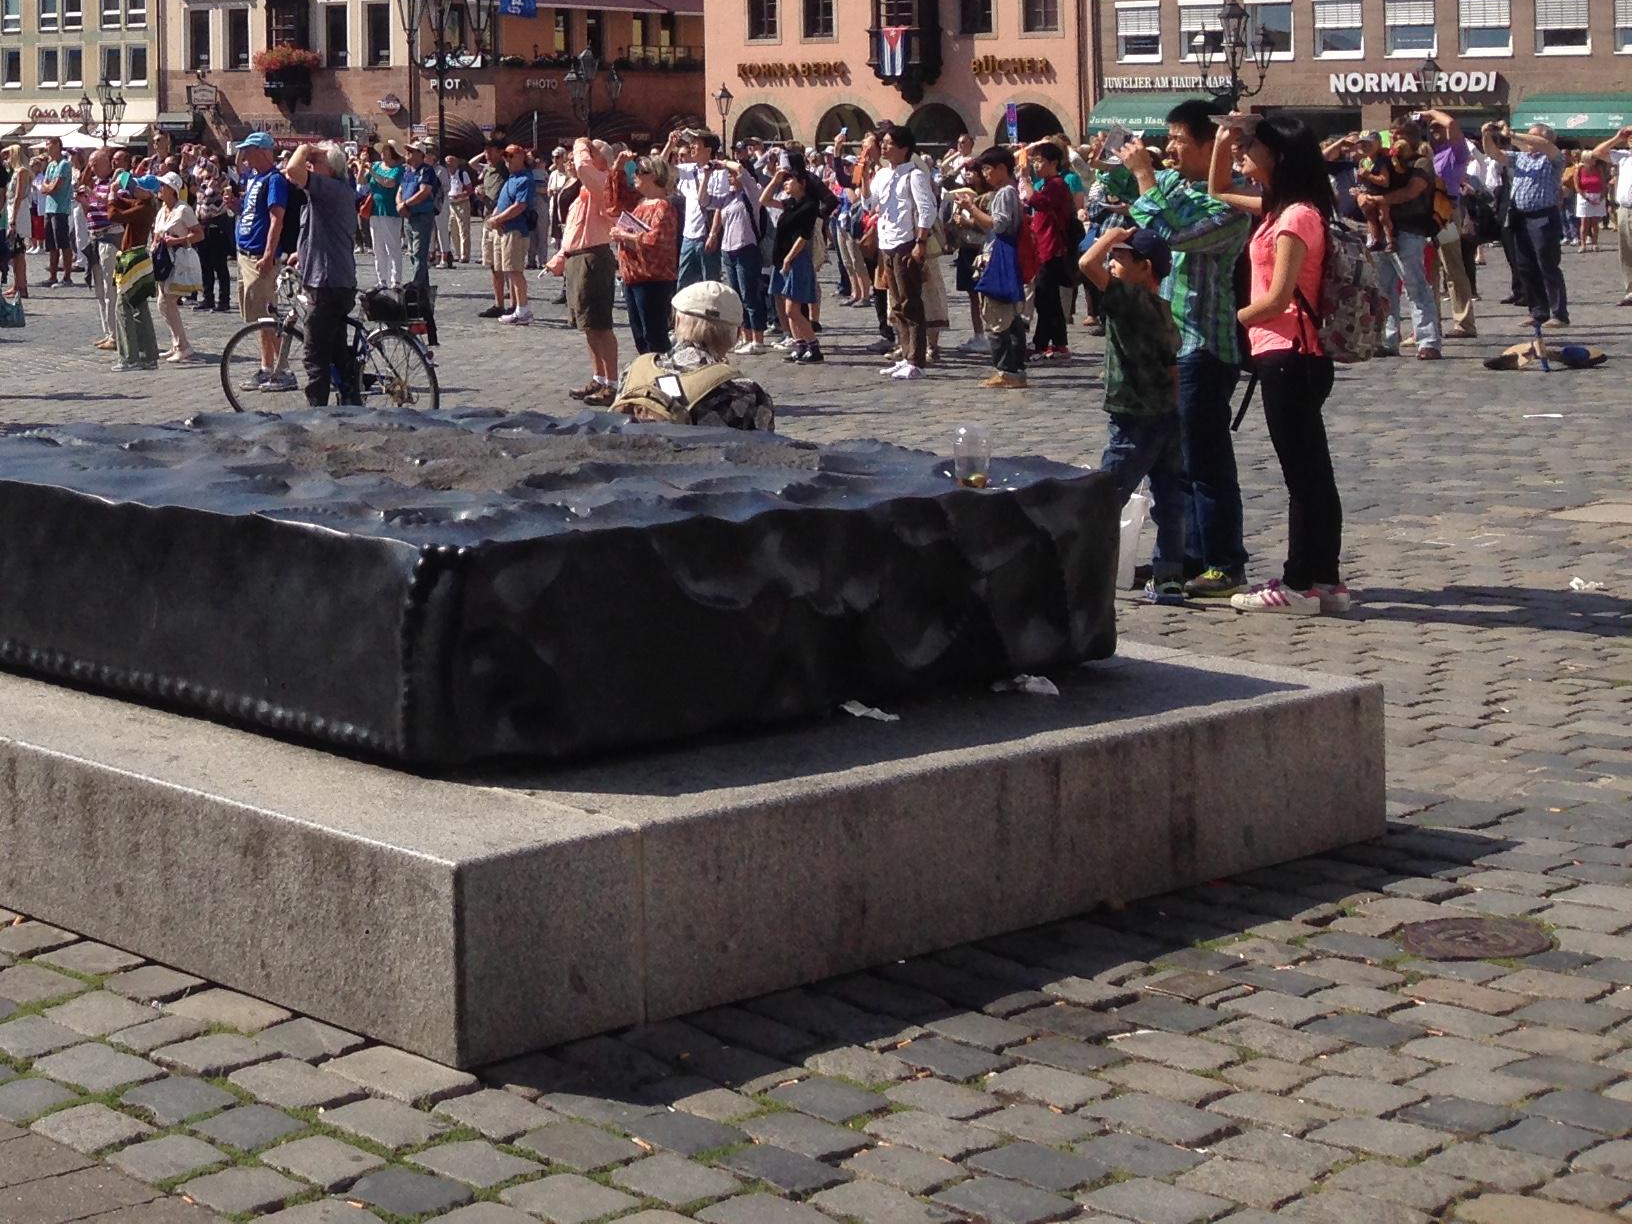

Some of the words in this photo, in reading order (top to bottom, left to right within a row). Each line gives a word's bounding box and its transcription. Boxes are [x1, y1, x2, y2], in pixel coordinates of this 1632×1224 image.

[971, 55, 1050, 76] BÜCHER
[526, 78, 558, 90] PHOTO
[1103, 76, 1152, 89] JUWELIER
[1154, 76, 1169, 88] AM
[1171, 75, 1234, 88] HAUPTMARK
[1329, 72, 1418, 93] NORMA
[1434, 71, 1497, 93] RODI
